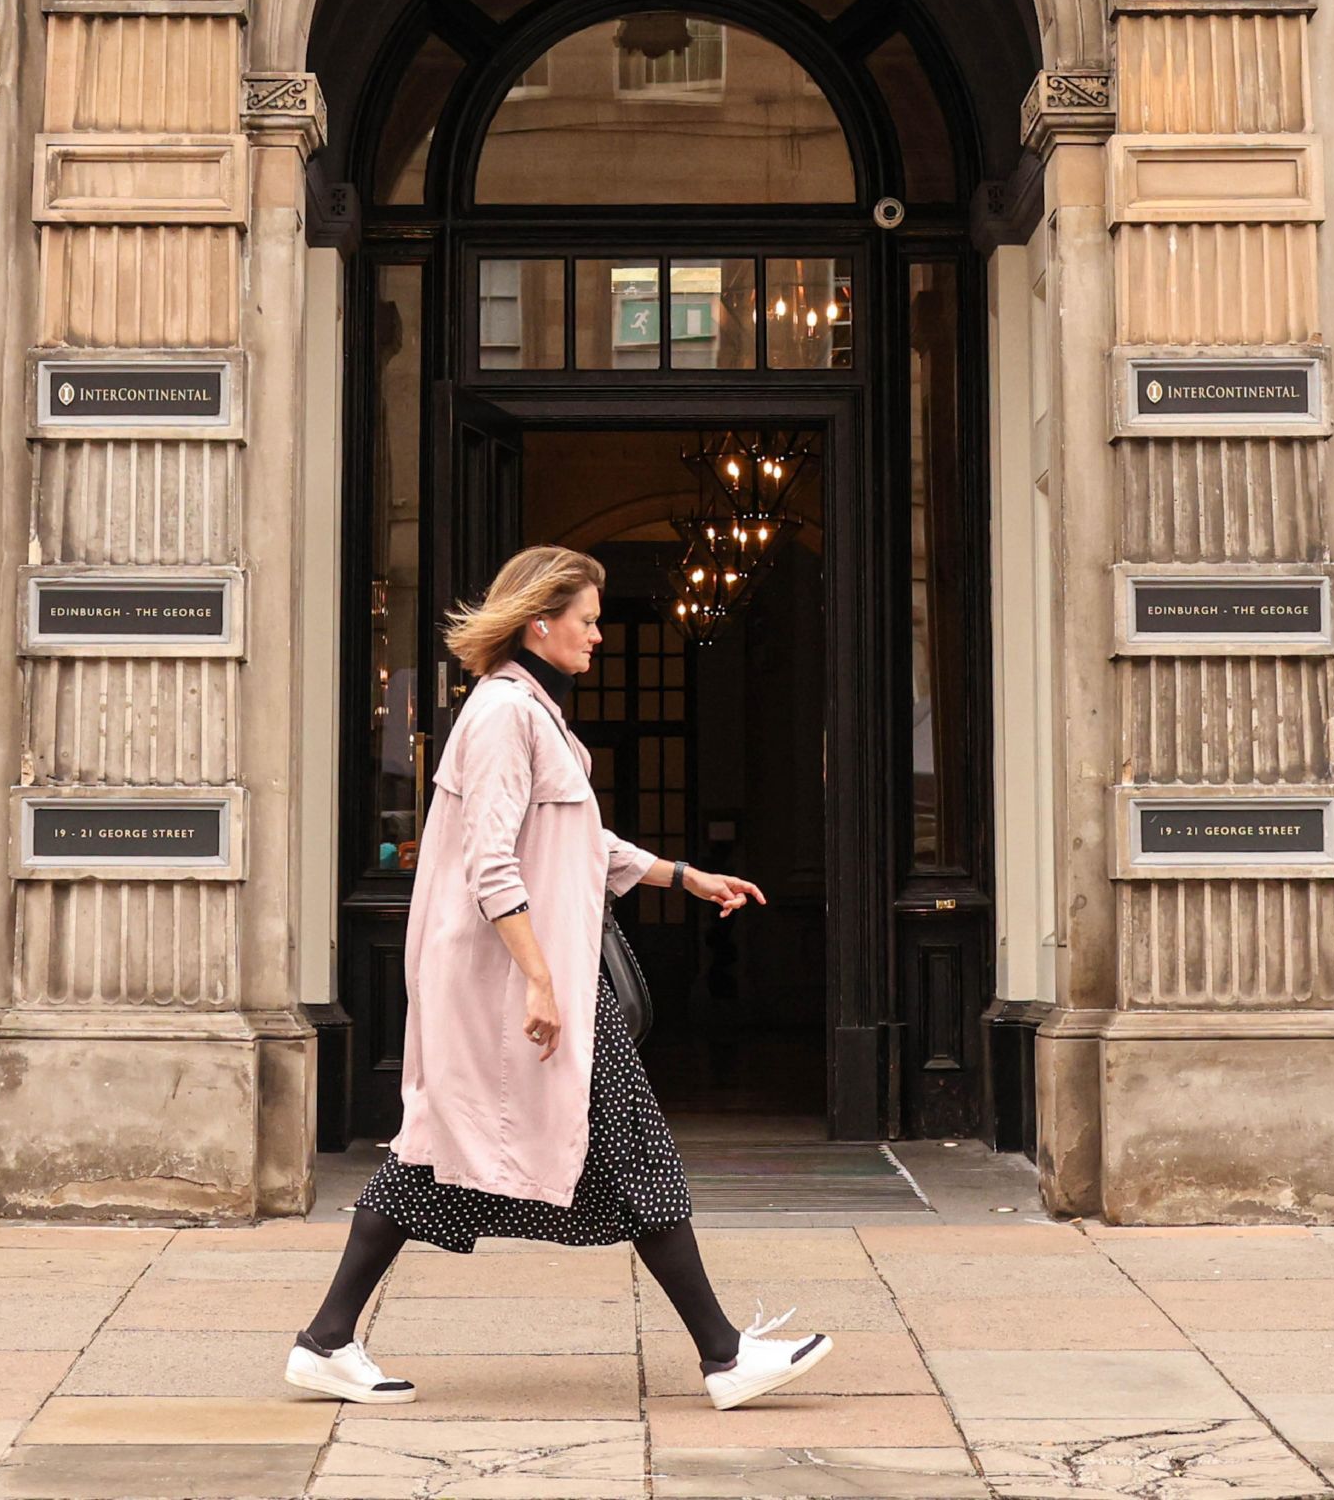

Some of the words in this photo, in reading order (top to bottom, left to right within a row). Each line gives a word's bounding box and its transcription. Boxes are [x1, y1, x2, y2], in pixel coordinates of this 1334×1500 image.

[50, 607, 121, 618] EDINBURGH
[135, 607, 158, 618] THE
[162, 607, 212, 618] GEORGE
[1147, 605, 1218, 616] EDINBURGH
[1232, 605, 1256, 616] THE
[1260, 605, 1309, 616] GEORGE
[54, 828, 67, 839] 19
[80, 828, 93, 839] 21
[98, 828, 148, 839] GEORGE
[152, 828, 195, 839] STREET
[1160, 825, 1172, 836] 19
[1185, 825, 1198, 836] 21
[1204, 825, 1254, 836] GEORGE
[1258, 825, 1302, 836] STREET
